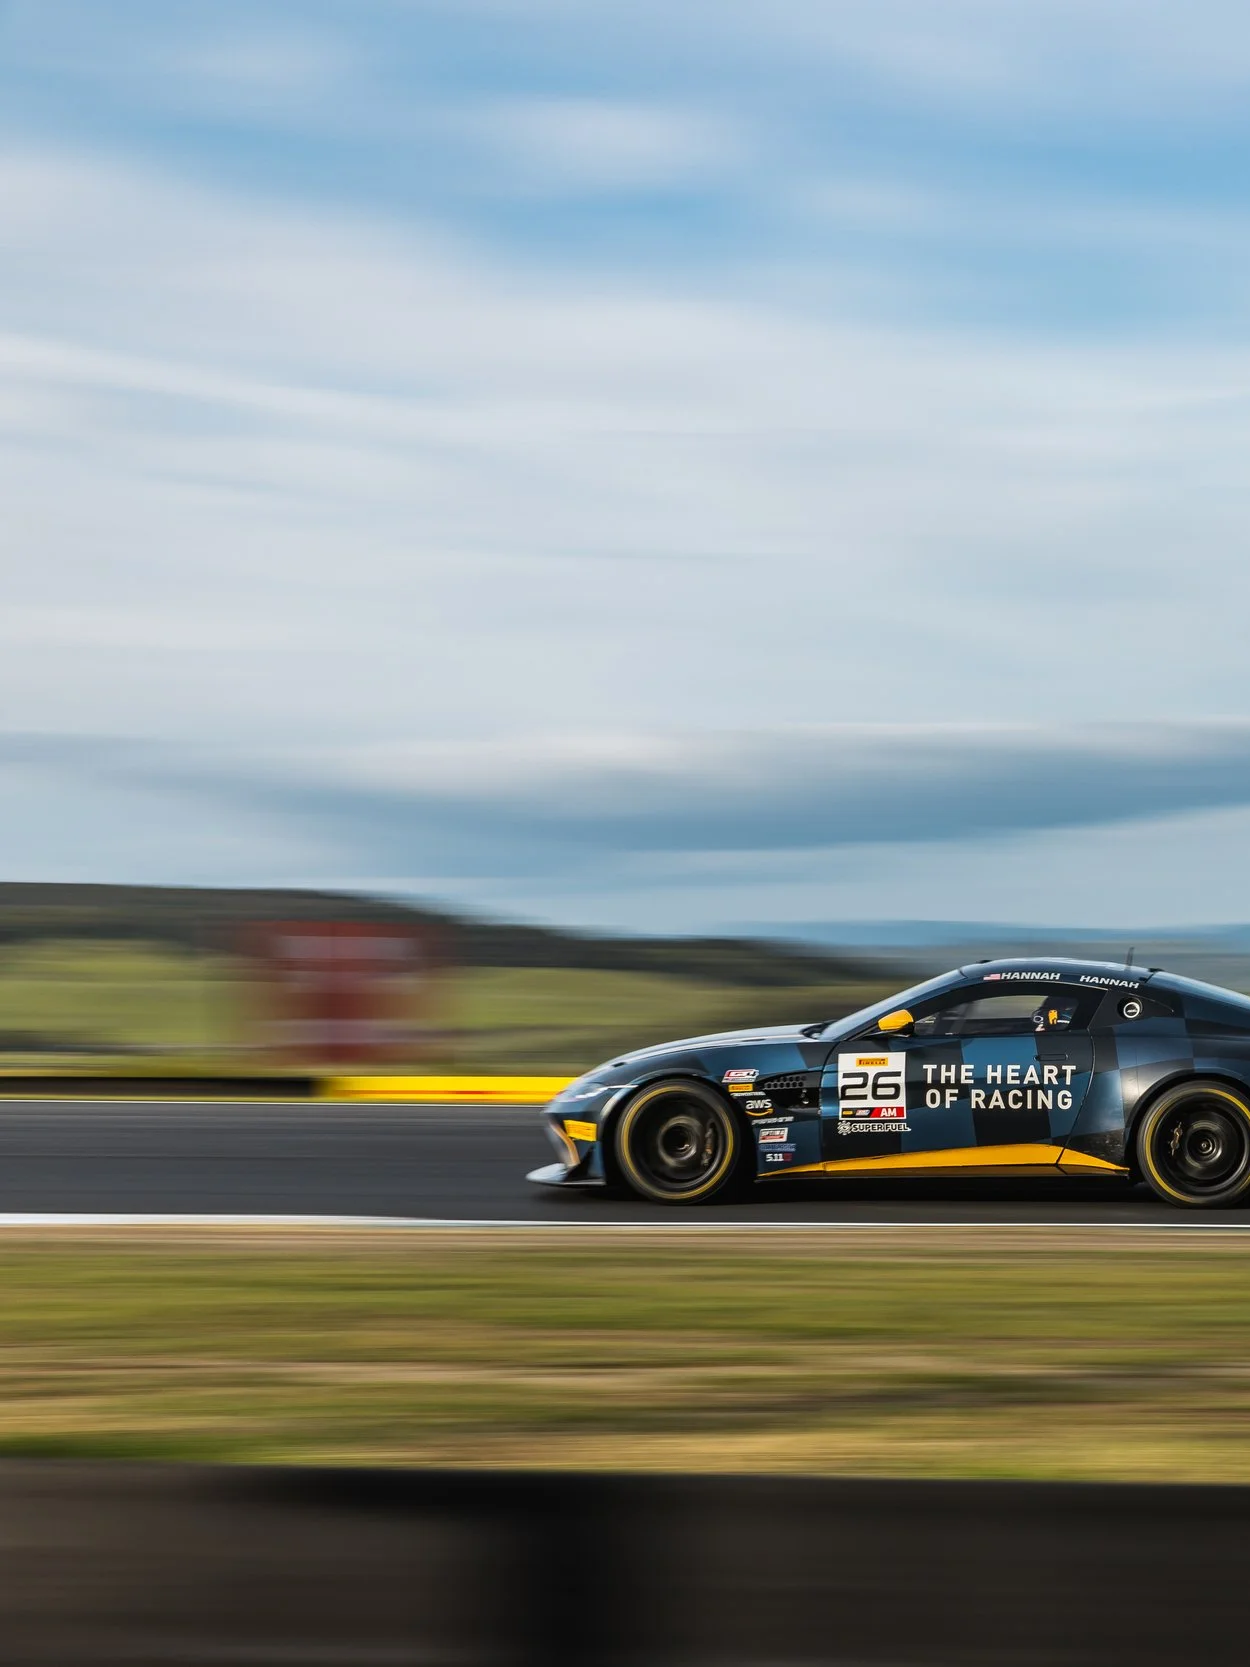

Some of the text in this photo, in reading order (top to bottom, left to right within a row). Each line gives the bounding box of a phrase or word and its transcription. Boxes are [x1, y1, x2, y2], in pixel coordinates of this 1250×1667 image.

[1001, 972, 1061, 981] HANNAH
[1079, 975, 1140, 989] HANNAH
[922, 1064, 1077, 1085] THE HEART
[840, 1071, 902, 1101] 26
[745, 1098, 773, 1110] aws
[925, 1088, 1073, 1109] OF RACING
[880, 1107, 897, 1117] AM
[852, 1122, 909, 1132] SUPER FUEL
